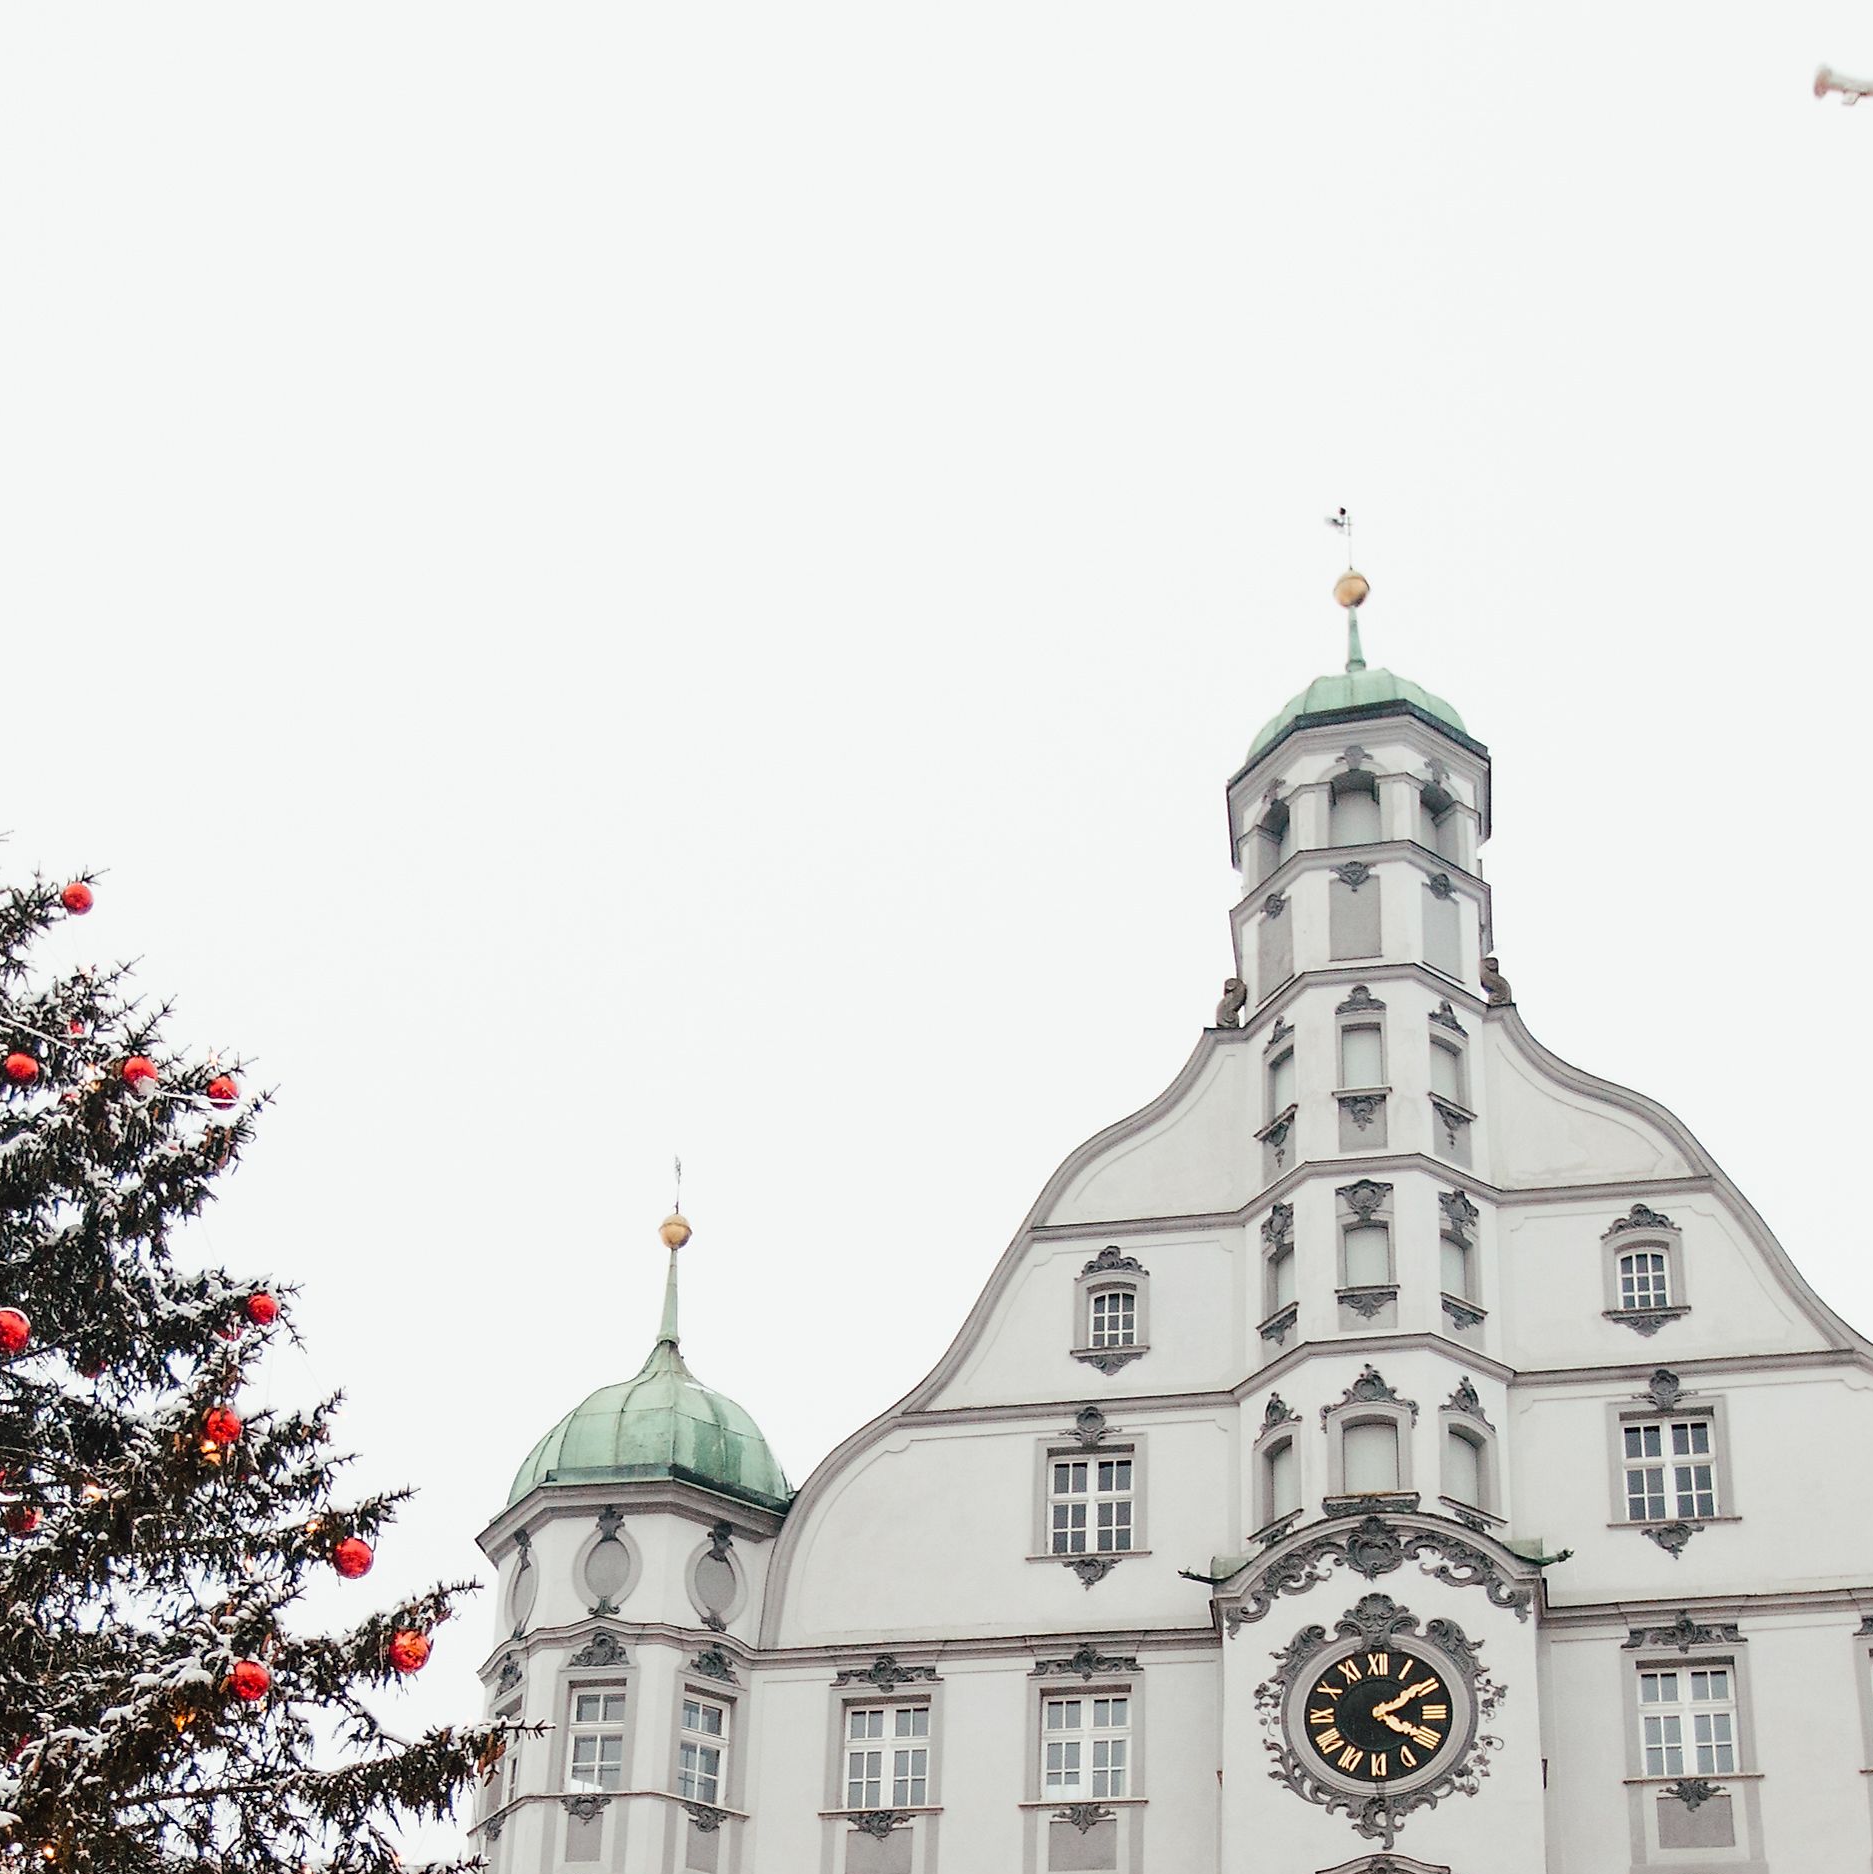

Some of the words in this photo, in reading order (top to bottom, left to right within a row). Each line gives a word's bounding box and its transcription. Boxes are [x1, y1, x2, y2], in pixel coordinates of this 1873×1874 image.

[1337, 1659, 1362, 1684] XI
[1367, 1653, 1388, 1675] XII
[1316, 1680, 1343, 1700] X
[1421, 1704, 1447, 1719] III
